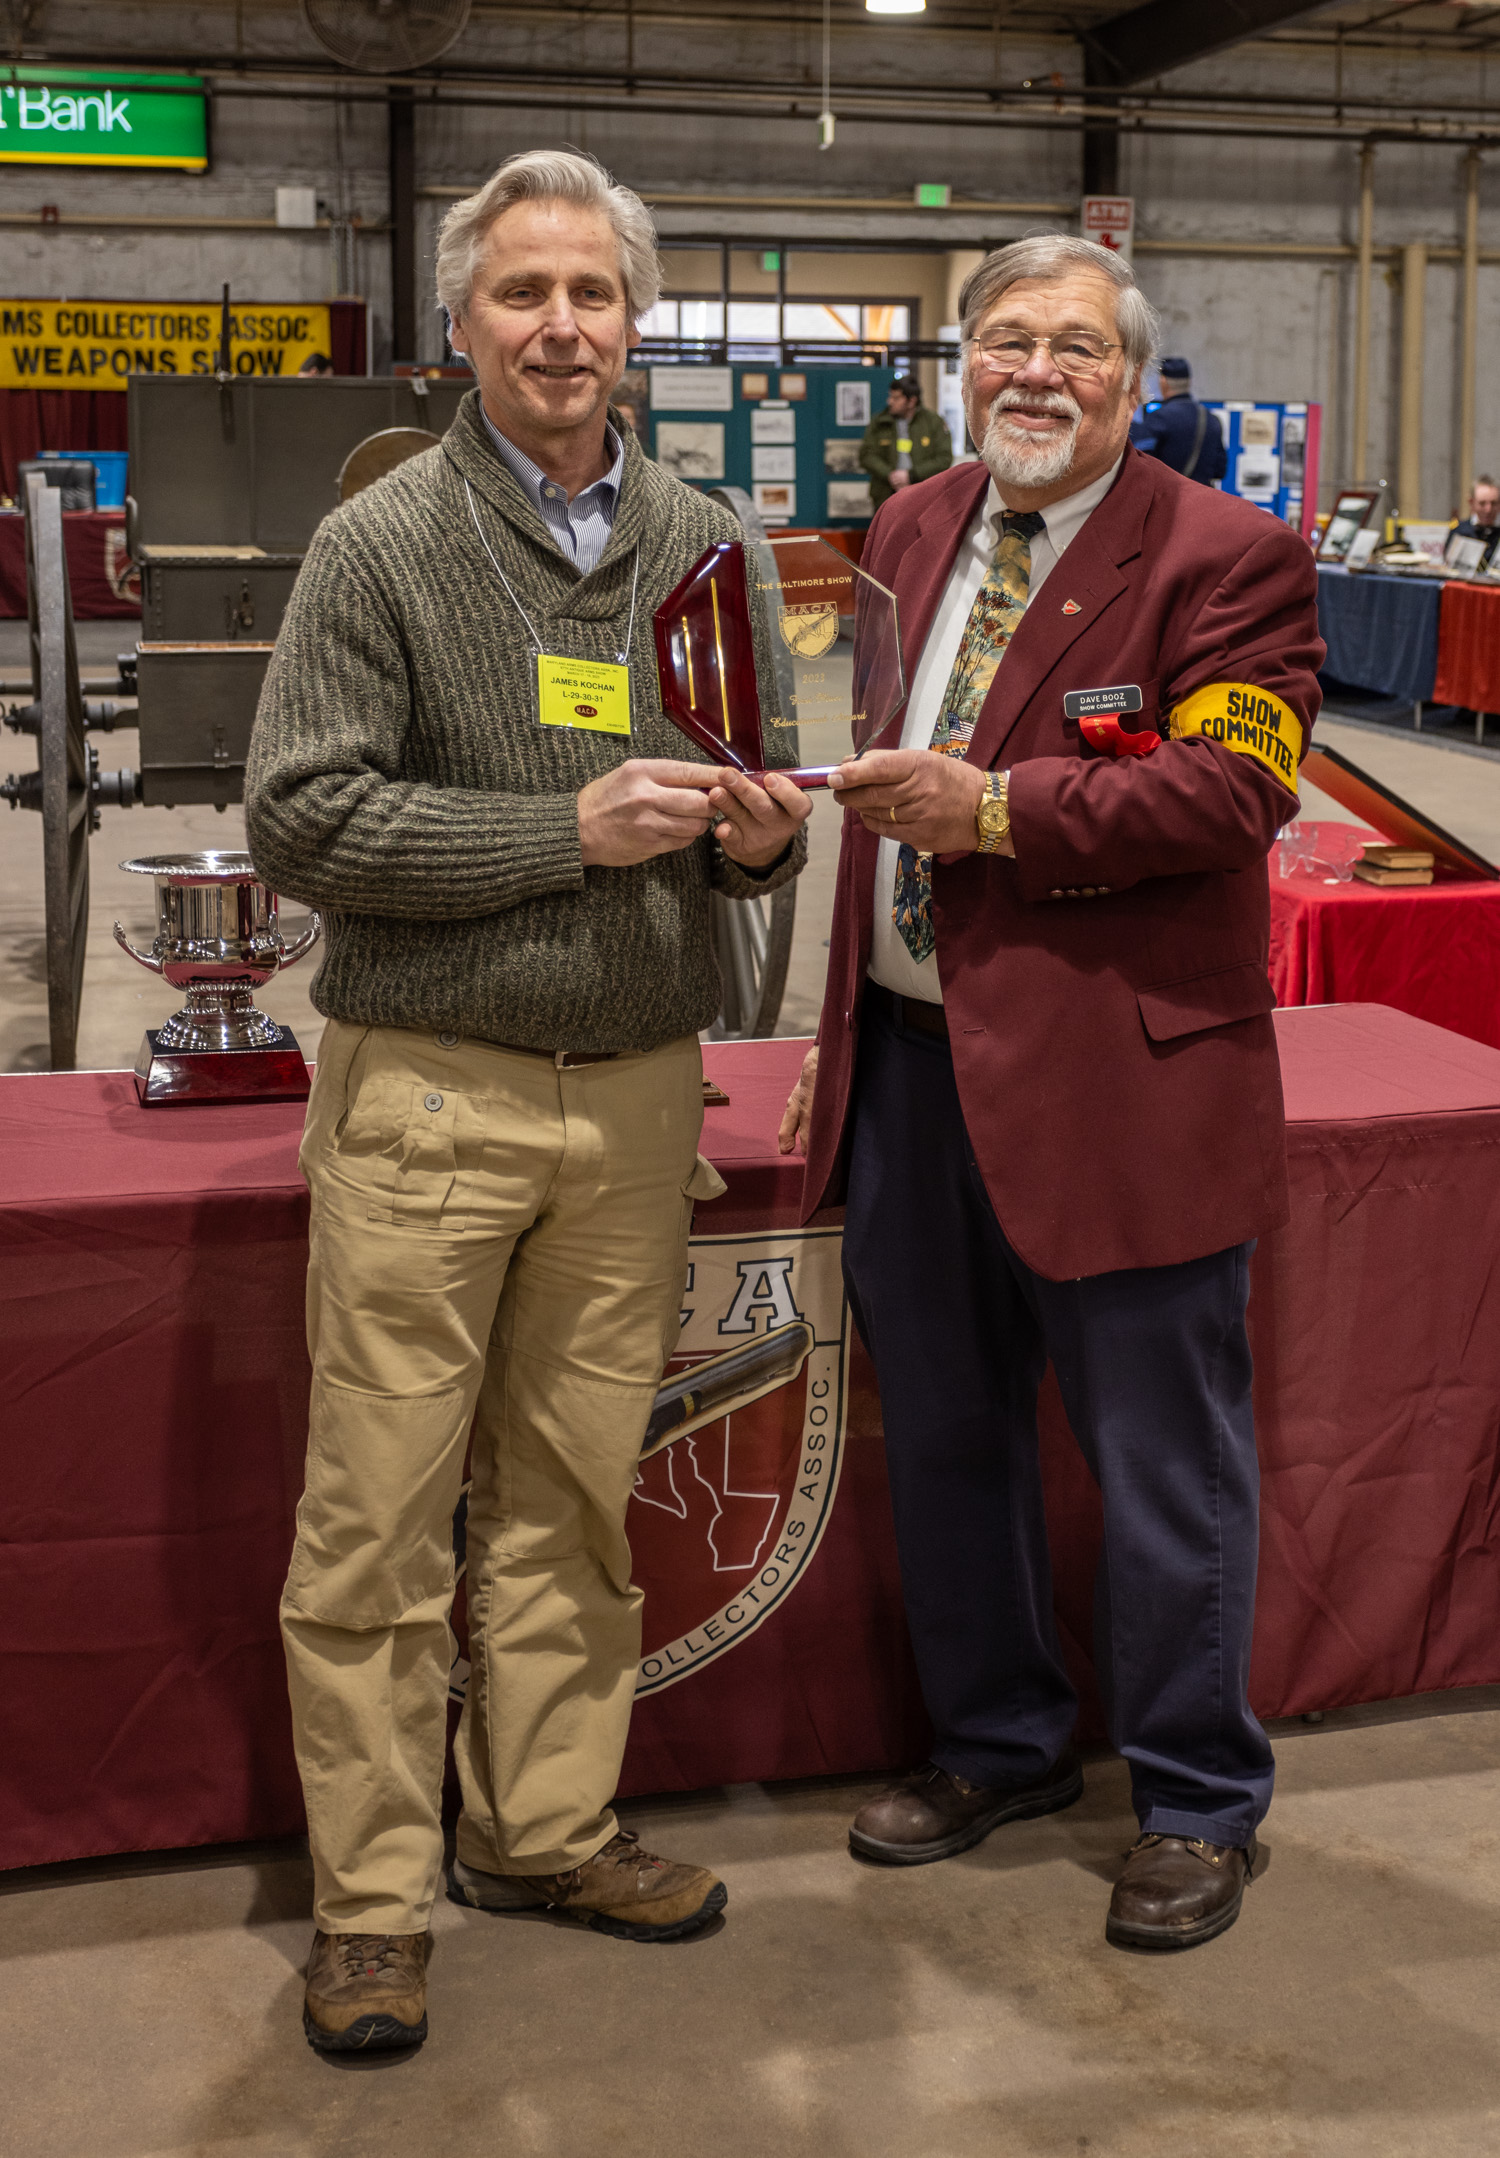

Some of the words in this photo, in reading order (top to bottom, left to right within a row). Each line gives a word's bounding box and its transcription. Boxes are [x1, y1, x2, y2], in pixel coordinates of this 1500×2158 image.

[19, 86, 133, 133] Bank
[56, 310, 210, 342] COLLECTORS
[13, 346, 178, 376] WEAPONS
[776, 578, 825, 589] BALTIMORE
[827, 576, 853, 585] SHOW
[782, 603, 835, 616] MACA
[550, 677, 579, 687] JAMES
[580, 681, 615, 692] KOCHAN
[802, 673, 825, 684] 2023
[562, 691, 604, 703] L-29-30-31
[1080, 695, 1101, 704] DAVE
[1102, 693, 1125, 702] BOOZ
[1096, 701, 1127, 709] COMMITTEE
[1227, 691, 1282, 734] SHOW
[1201, 717, 1294, 778] COMMITTEE
[799, 1367, 830, 1502] ASSOC.
